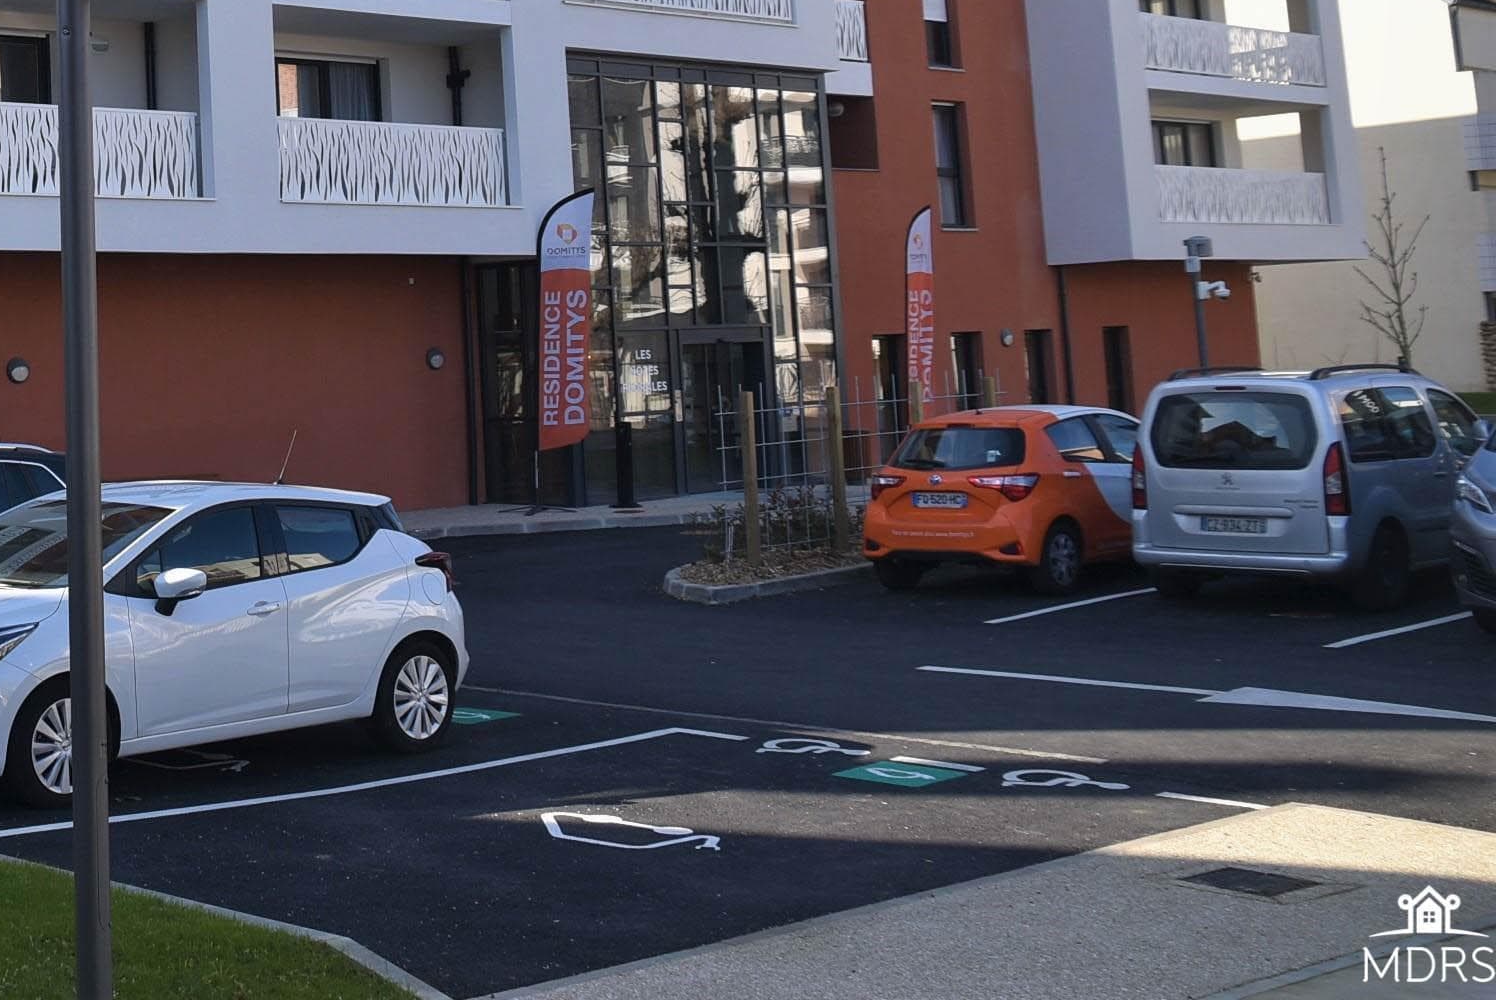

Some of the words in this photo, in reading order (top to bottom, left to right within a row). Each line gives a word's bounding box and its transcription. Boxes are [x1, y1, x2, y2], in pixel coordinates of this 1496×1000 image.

[543, 291, 561, 427] RESIDENCE
[564, 289, 587, 426] DOMITYS
[635, 349, 652, 360] LES
[908, 290, 920, 383] SIDENCE
